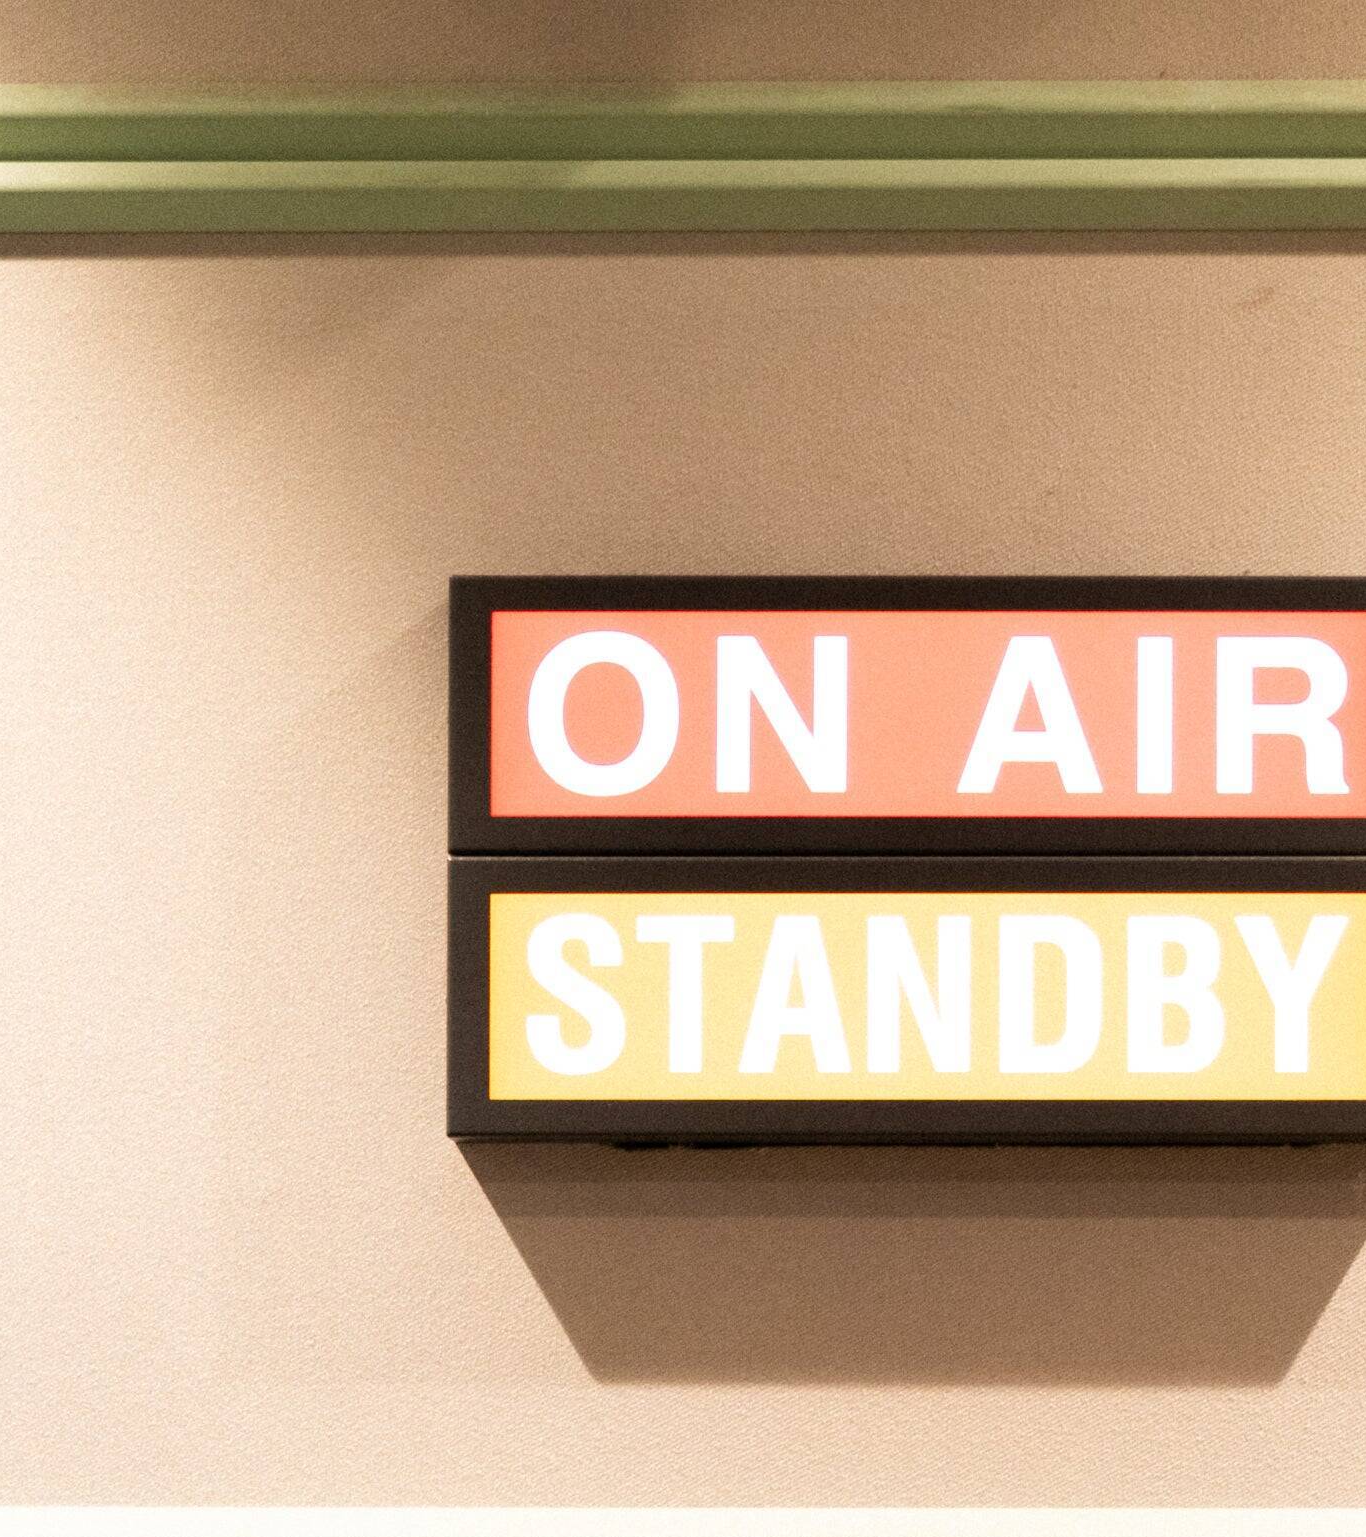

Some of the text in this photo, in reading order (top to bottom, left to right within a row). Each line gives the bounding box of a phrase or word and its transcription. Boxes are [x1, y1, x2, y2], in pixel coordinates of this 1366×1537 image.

[527, 630, 1350, 797] ON AIR
[524, 912, 1350, 1076] STANDBY
